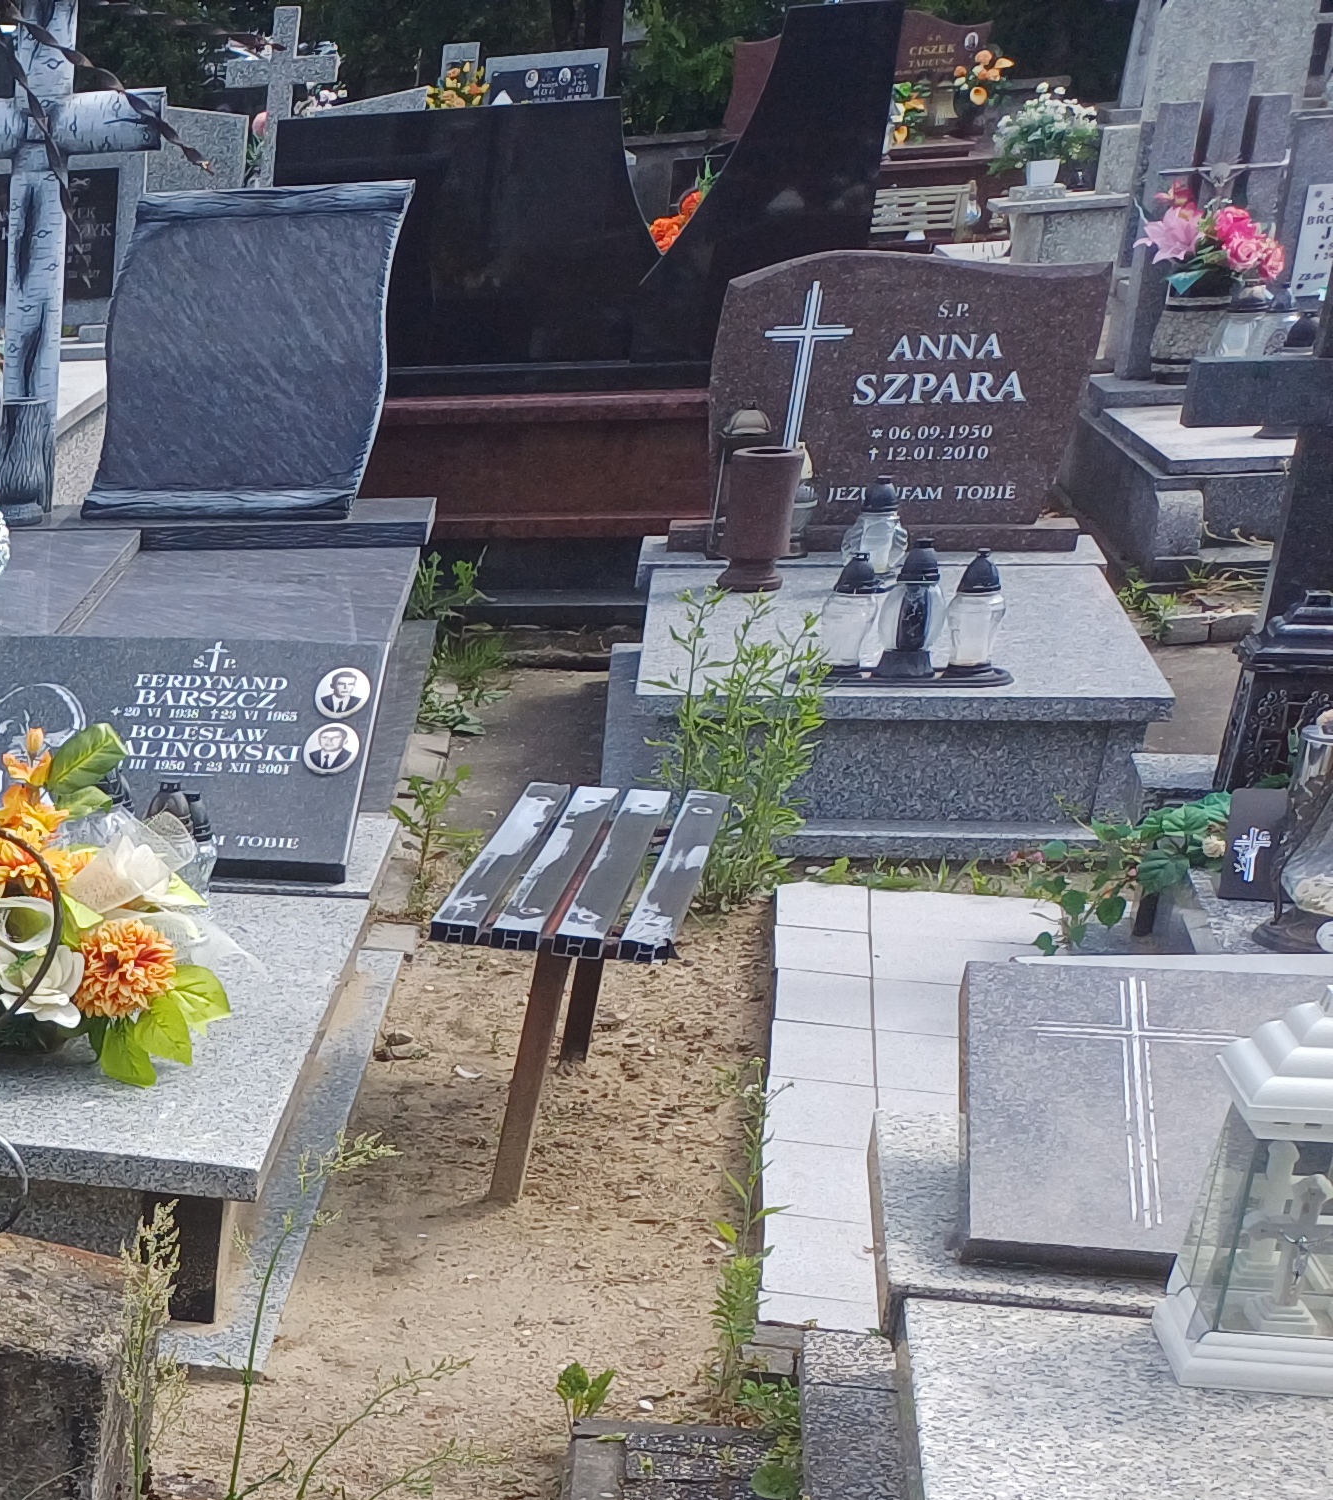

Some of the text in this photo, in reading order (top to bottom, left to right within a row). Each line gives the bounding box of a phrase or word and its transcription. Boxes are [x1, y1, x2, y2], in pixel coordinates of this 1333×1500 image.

[909, 44, 955, 55] CISZEK
[887, 333, 1002, 362] ANNA
[853, 371, 1026, 405] SZPARA
[888, 425, 993, 440] 06.09.1950
[886, 446, 989, 461] 12.01.2010
[955, 486, 1017, 500] TOBIE
[134, 673, 288, 691] FERDYNAND
[135, 689, 277, 710] BARSZCZ
[169, 708, 200, 719] 1938
[130, 724, 268, 742] BOLESŁAW
[125, 740, 301, 762] ALINOWSKI
[154, 760, 185, 771] 1950
